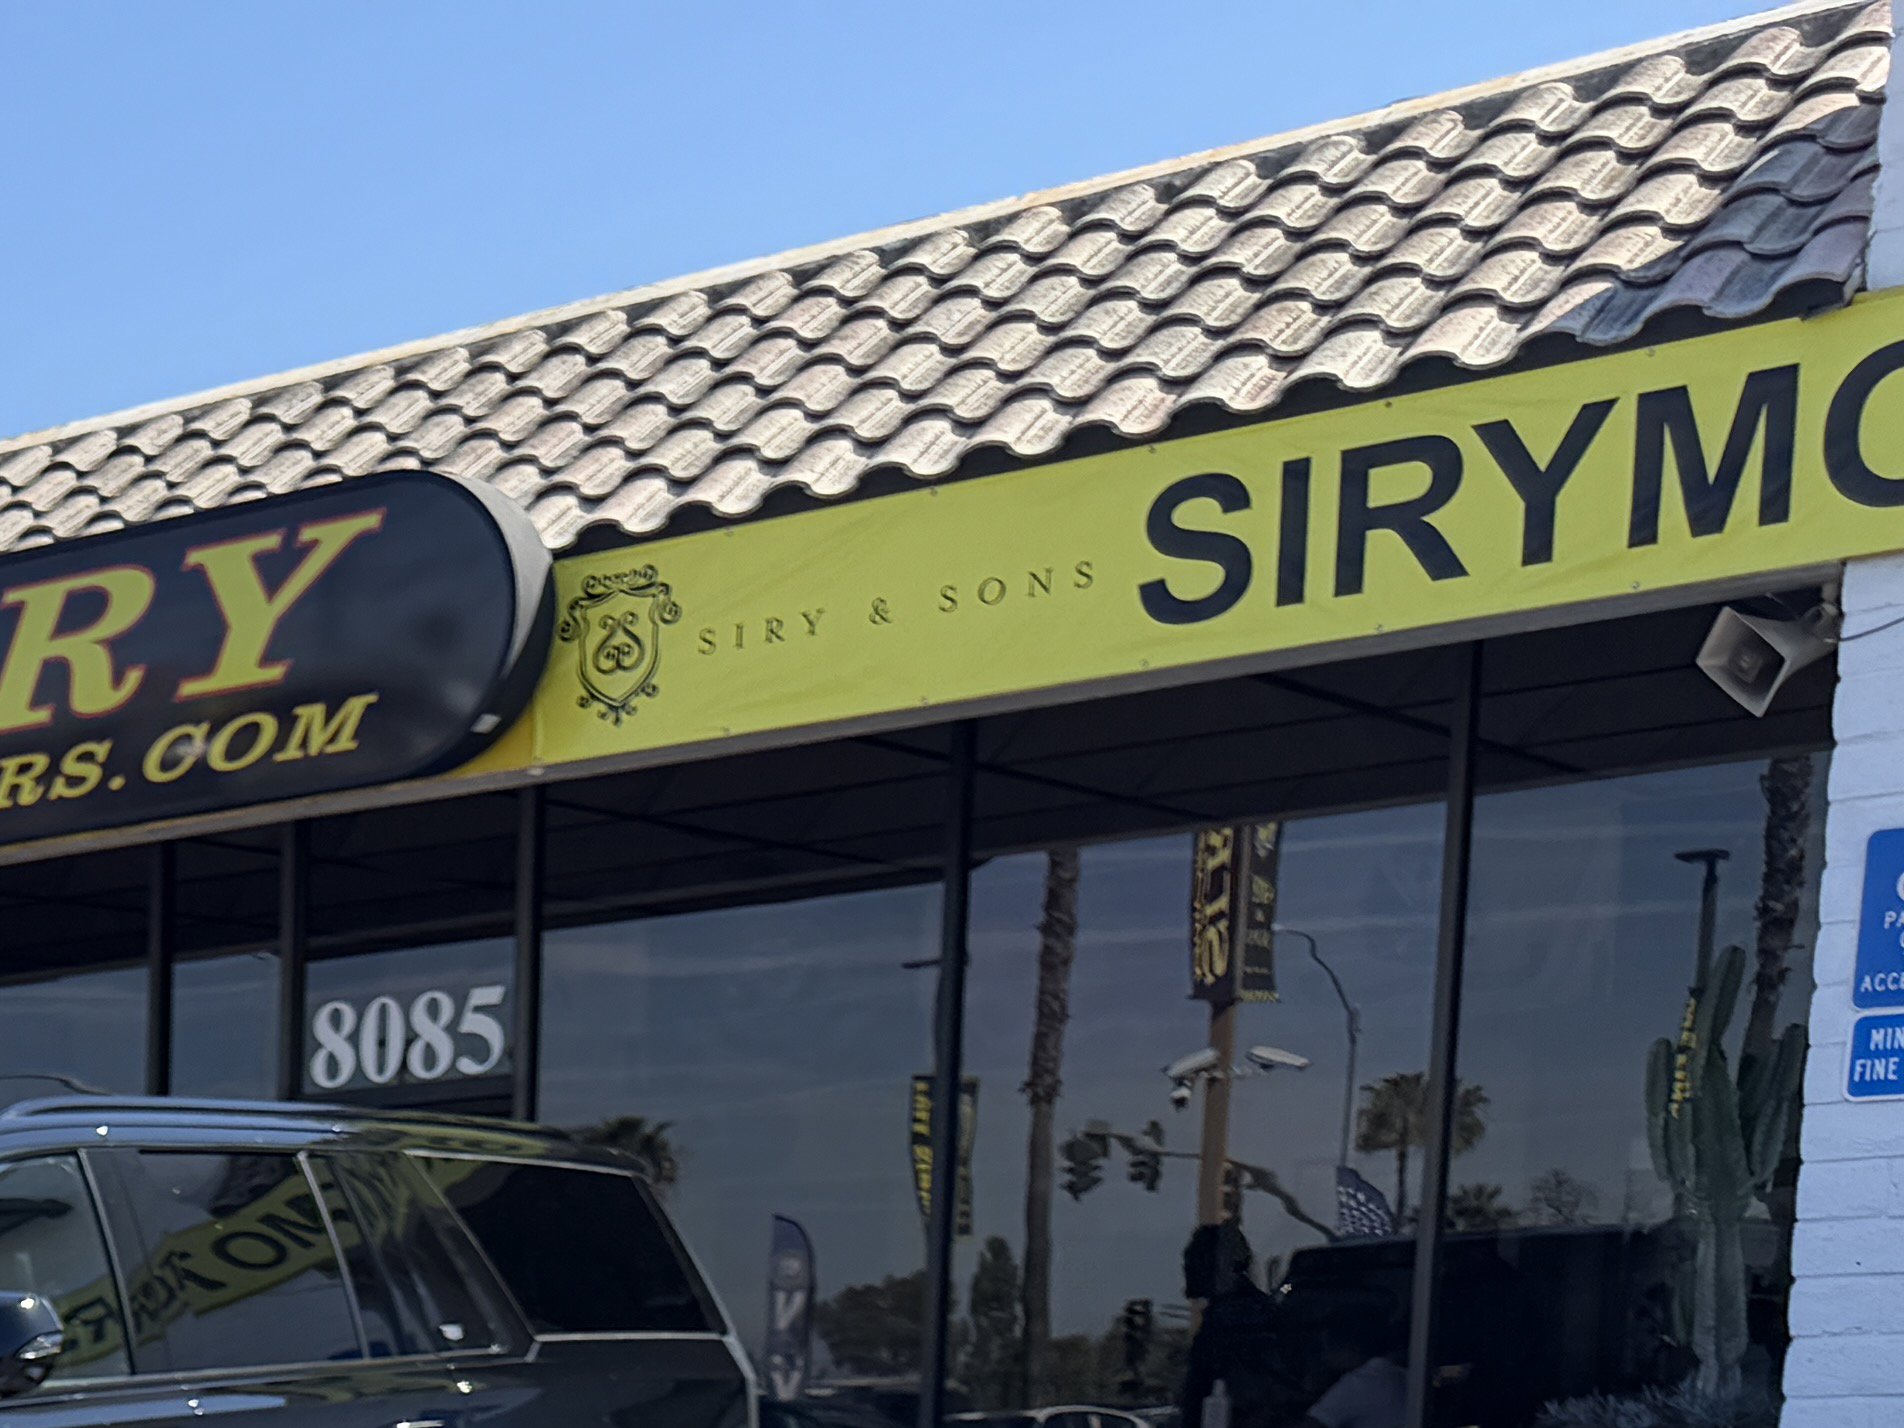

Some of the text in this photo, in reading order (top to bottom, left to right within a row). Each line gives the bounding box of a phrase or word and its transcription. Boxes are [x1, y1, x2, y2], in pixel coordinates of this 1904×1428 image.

[697, 559, 1094, 656] SIRY & SONS
[309, 985, 507, 1089] 8085
[1853, 1056, 1899, 1082] FINE
